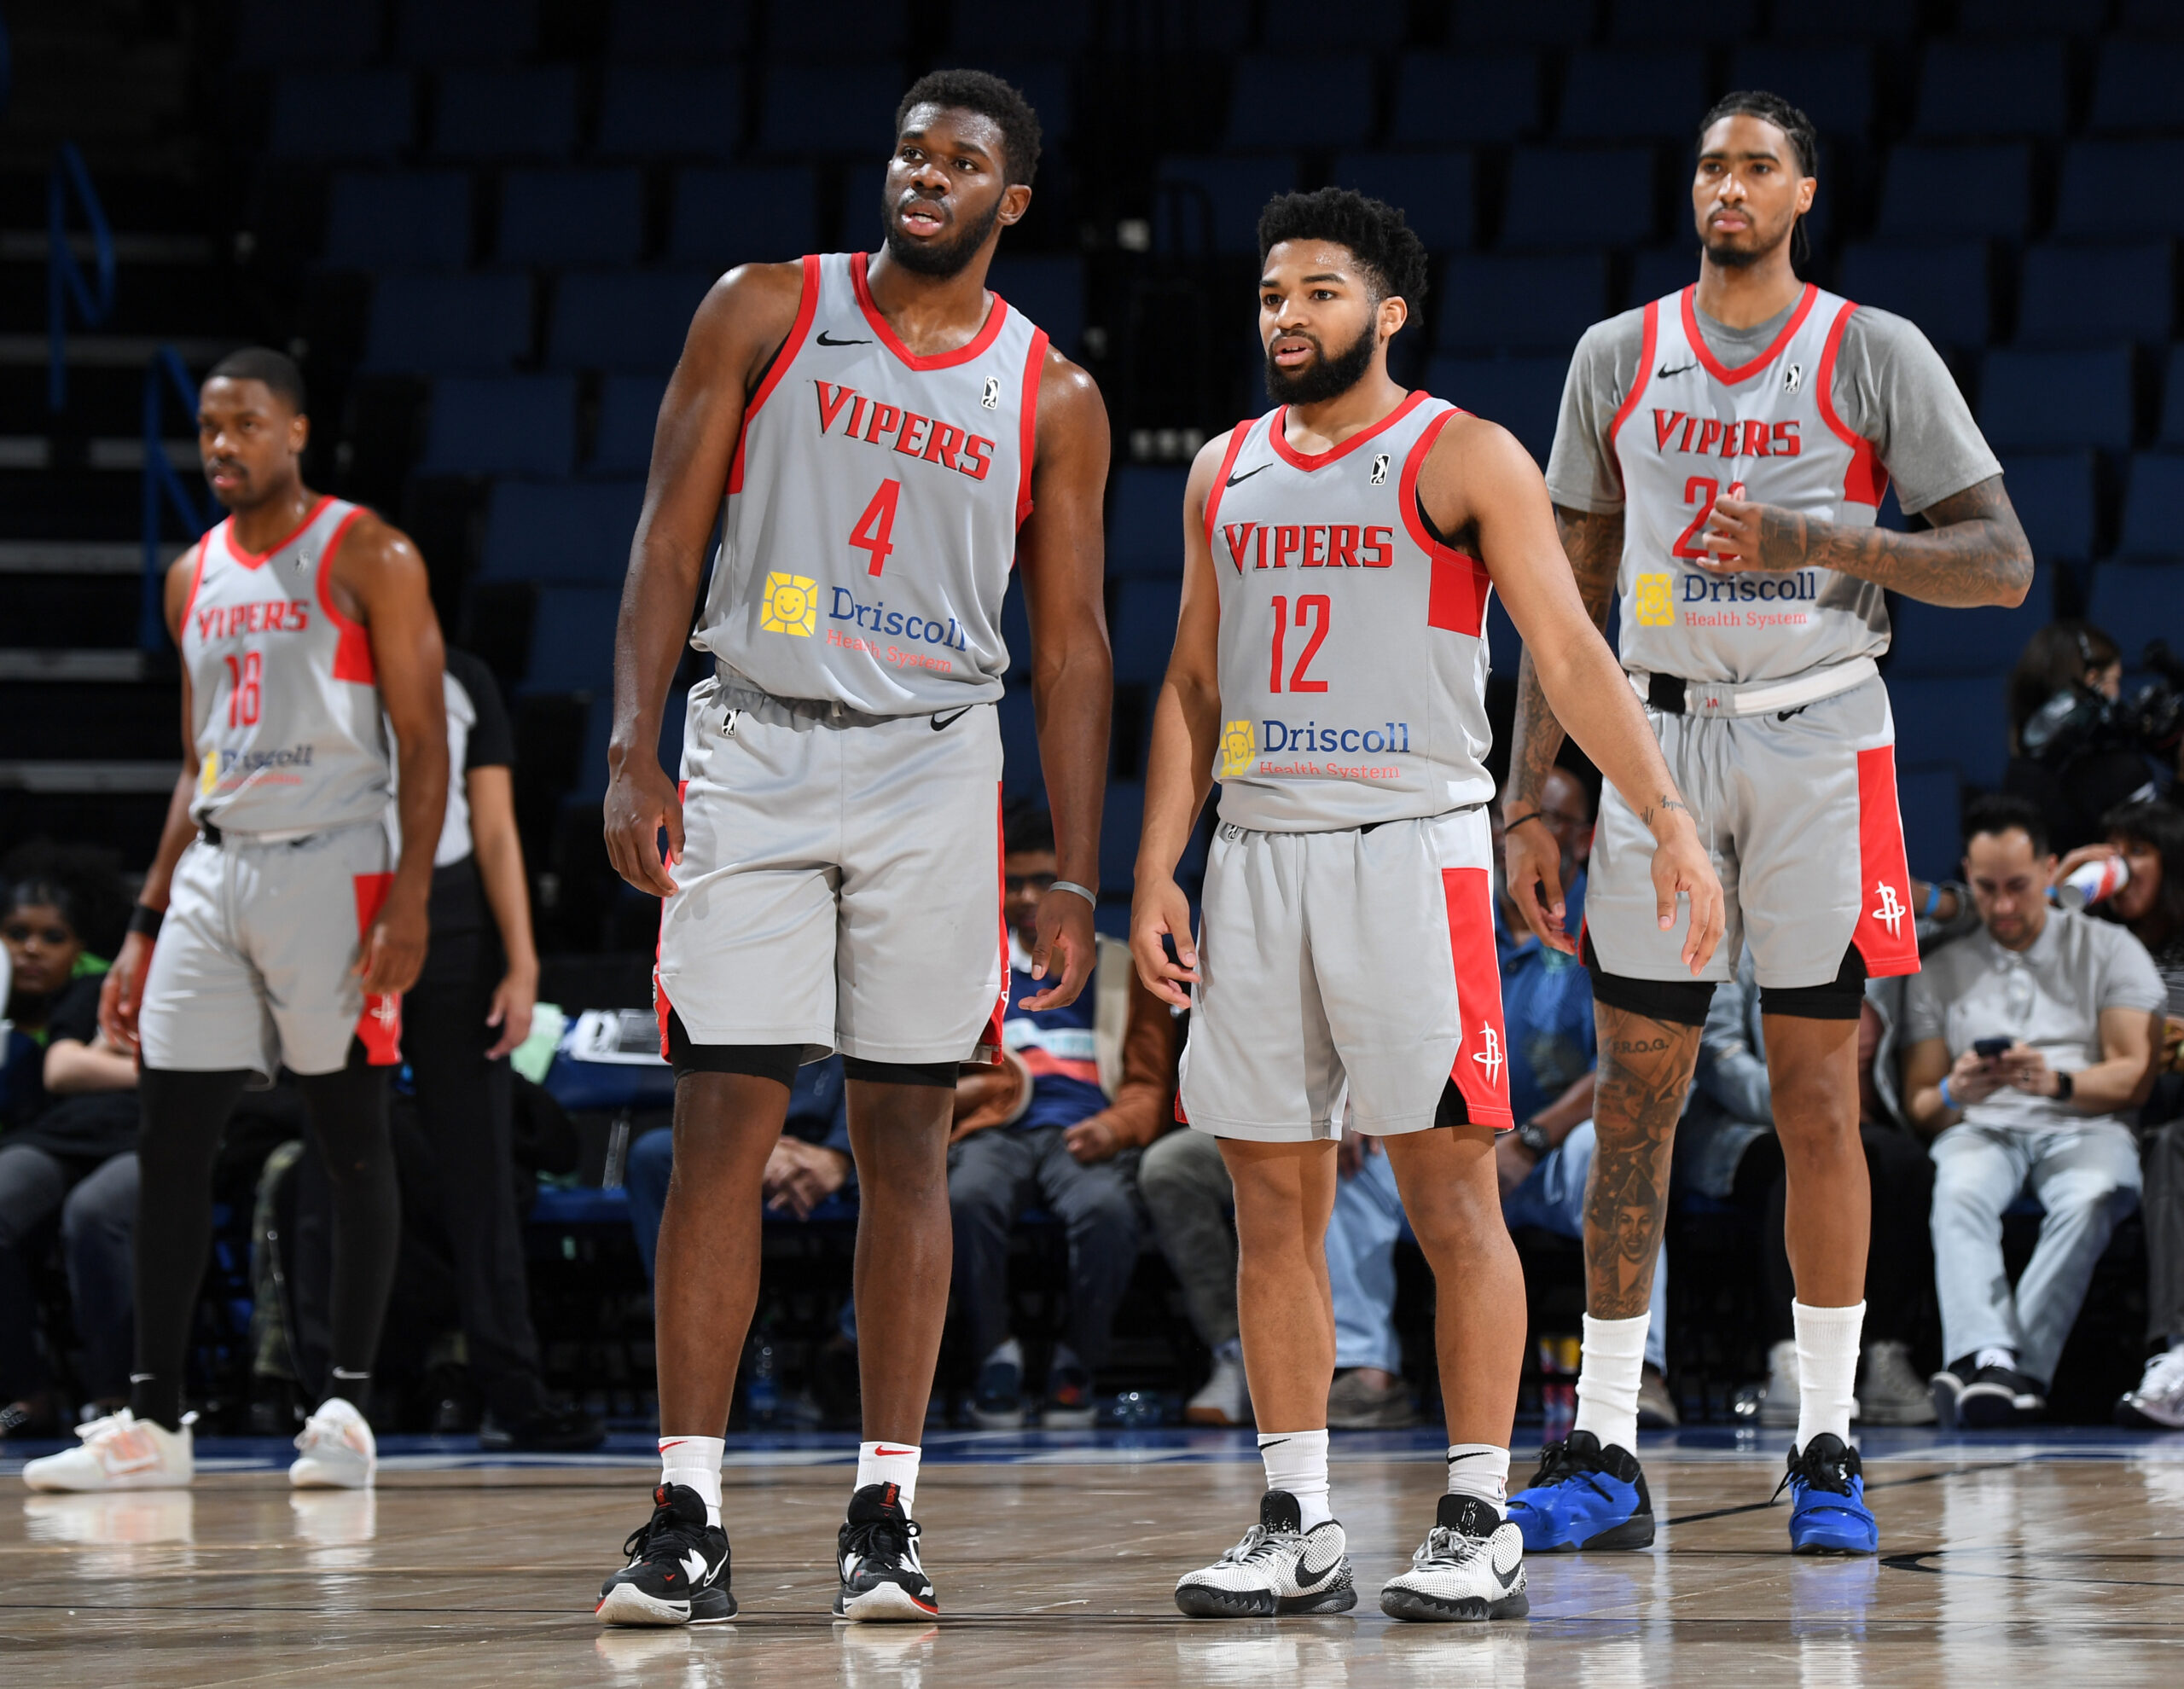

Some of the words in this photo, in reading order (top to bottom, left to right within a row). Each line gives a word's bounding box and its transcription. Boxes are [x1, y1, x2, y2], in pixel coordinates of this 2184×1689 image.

[814, 380, 996, 483] VIPERS
[1653, 408, 1801, 458] VIPERS
[849, 479, 900, 577] 4
[1224, 522, 1393, 575] VIPERS
[1683, 572, 1815, 602] Driscoll
[197, 599, 310, 643] VIPERS
[829, 586, 967, 652] Driscoll
[1270, 595, 1330, 693] 12
[1684, 611, 1741, 627] Health
[1745, 611, 1807, 631] System
[886, 645, 952, 674] System
[224, 651, 262, 729] 18
[1263, 720, 1410, 753] Driscoll
[1326, 762, 1401, 781] System
